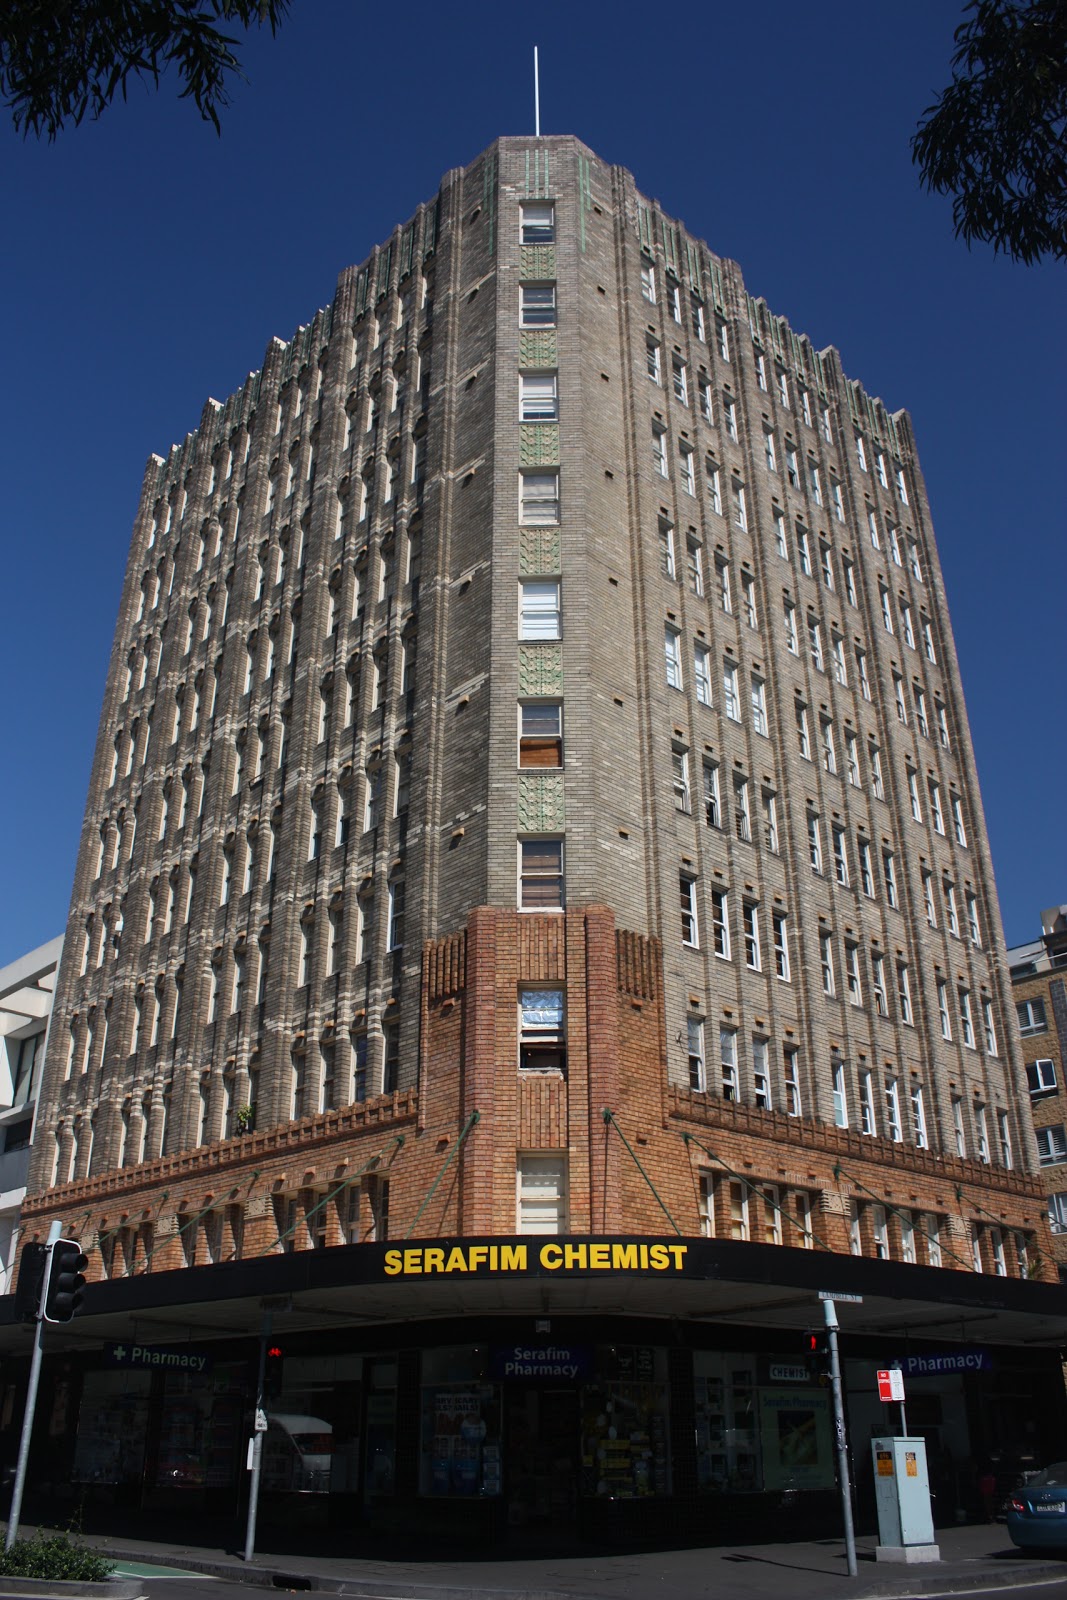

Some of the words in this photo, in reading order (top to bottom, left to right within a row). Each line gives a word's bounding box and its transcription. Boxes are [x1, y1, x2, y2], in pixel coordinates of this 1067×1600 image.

[384, 1245, 527, 1274] SERAFIM
[540, 1243, 688, 1270] CHEMIST
[131, 1347, 207, 1371] Pharmacy
[513, 1346, 571, 1361] Serafim
[907, 1353, 983, 1372] Pharmacy
[504, 1361, 579, 1379] Pharmacy
[772, 1367, 808, 1378] CHEMIST
[763, 1395, 792, 1408] Serafim
[792, 1395, 827, 1411] Pharmacy
